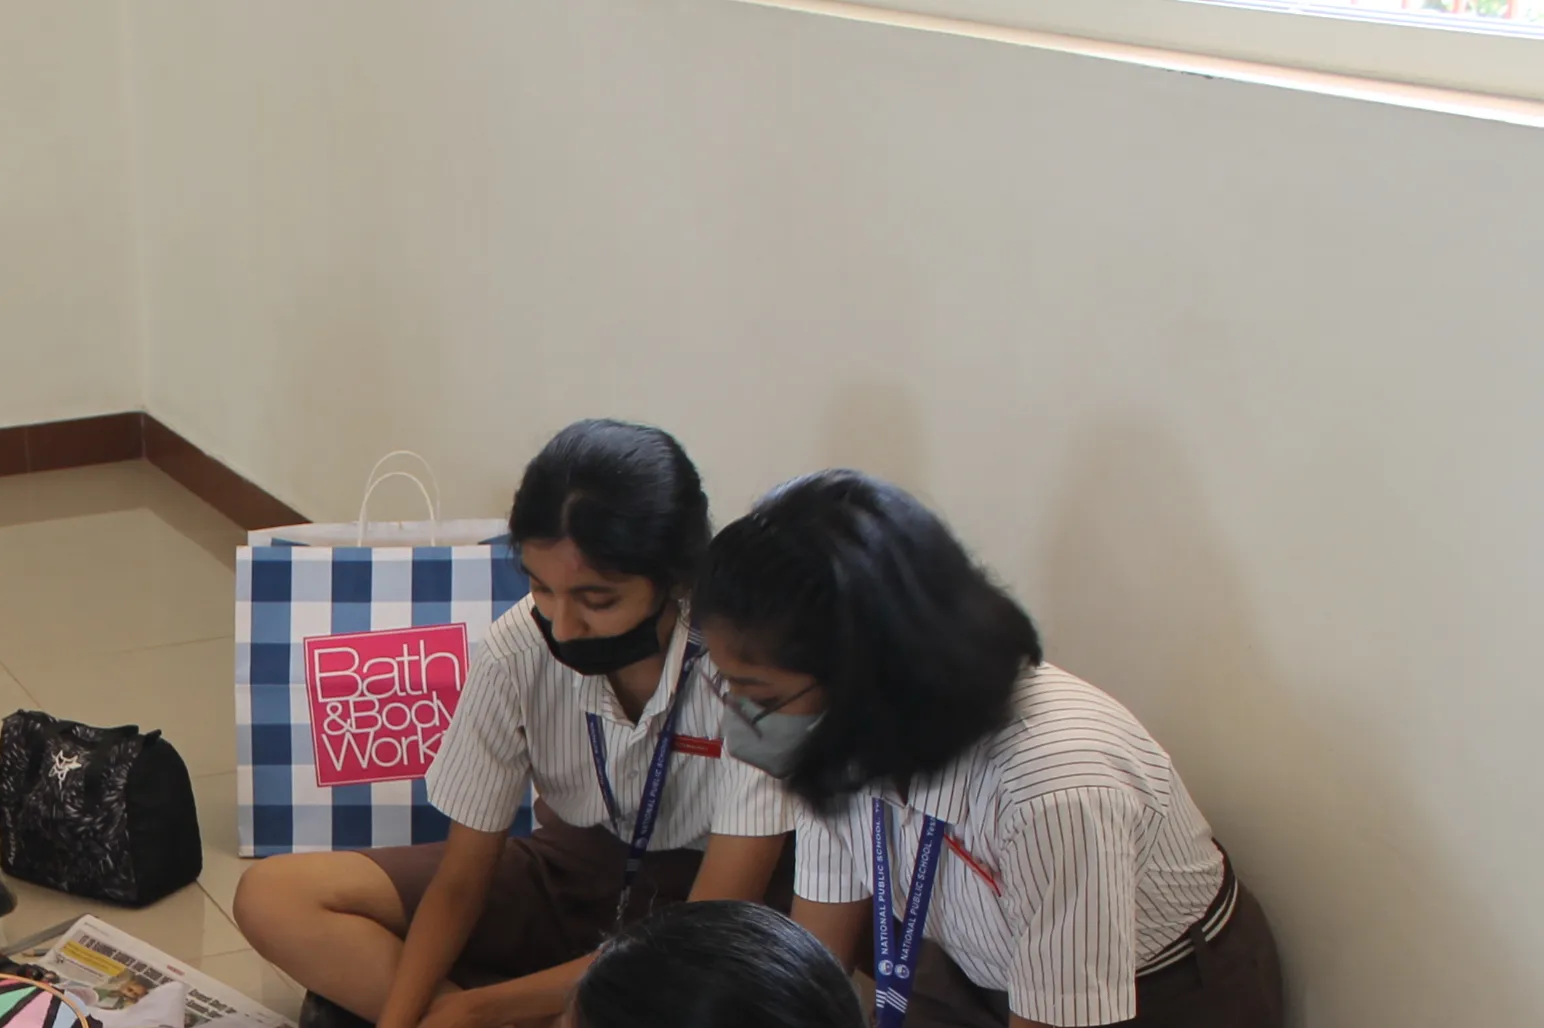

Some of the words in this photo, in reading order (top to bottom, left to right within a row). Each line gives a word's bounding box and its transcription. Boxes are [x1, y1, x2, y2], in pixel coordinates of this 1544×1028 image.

[313, 639, 461, 703] Bath
[321, 726, 449, 772] Work
[877, 864, 886, 902] PUBLIC
[879, 905, 890, 955] NATIONAL
[899, 917, 917, 962] NATIONAL
[910, 881, 924, 916] PUBLIC
